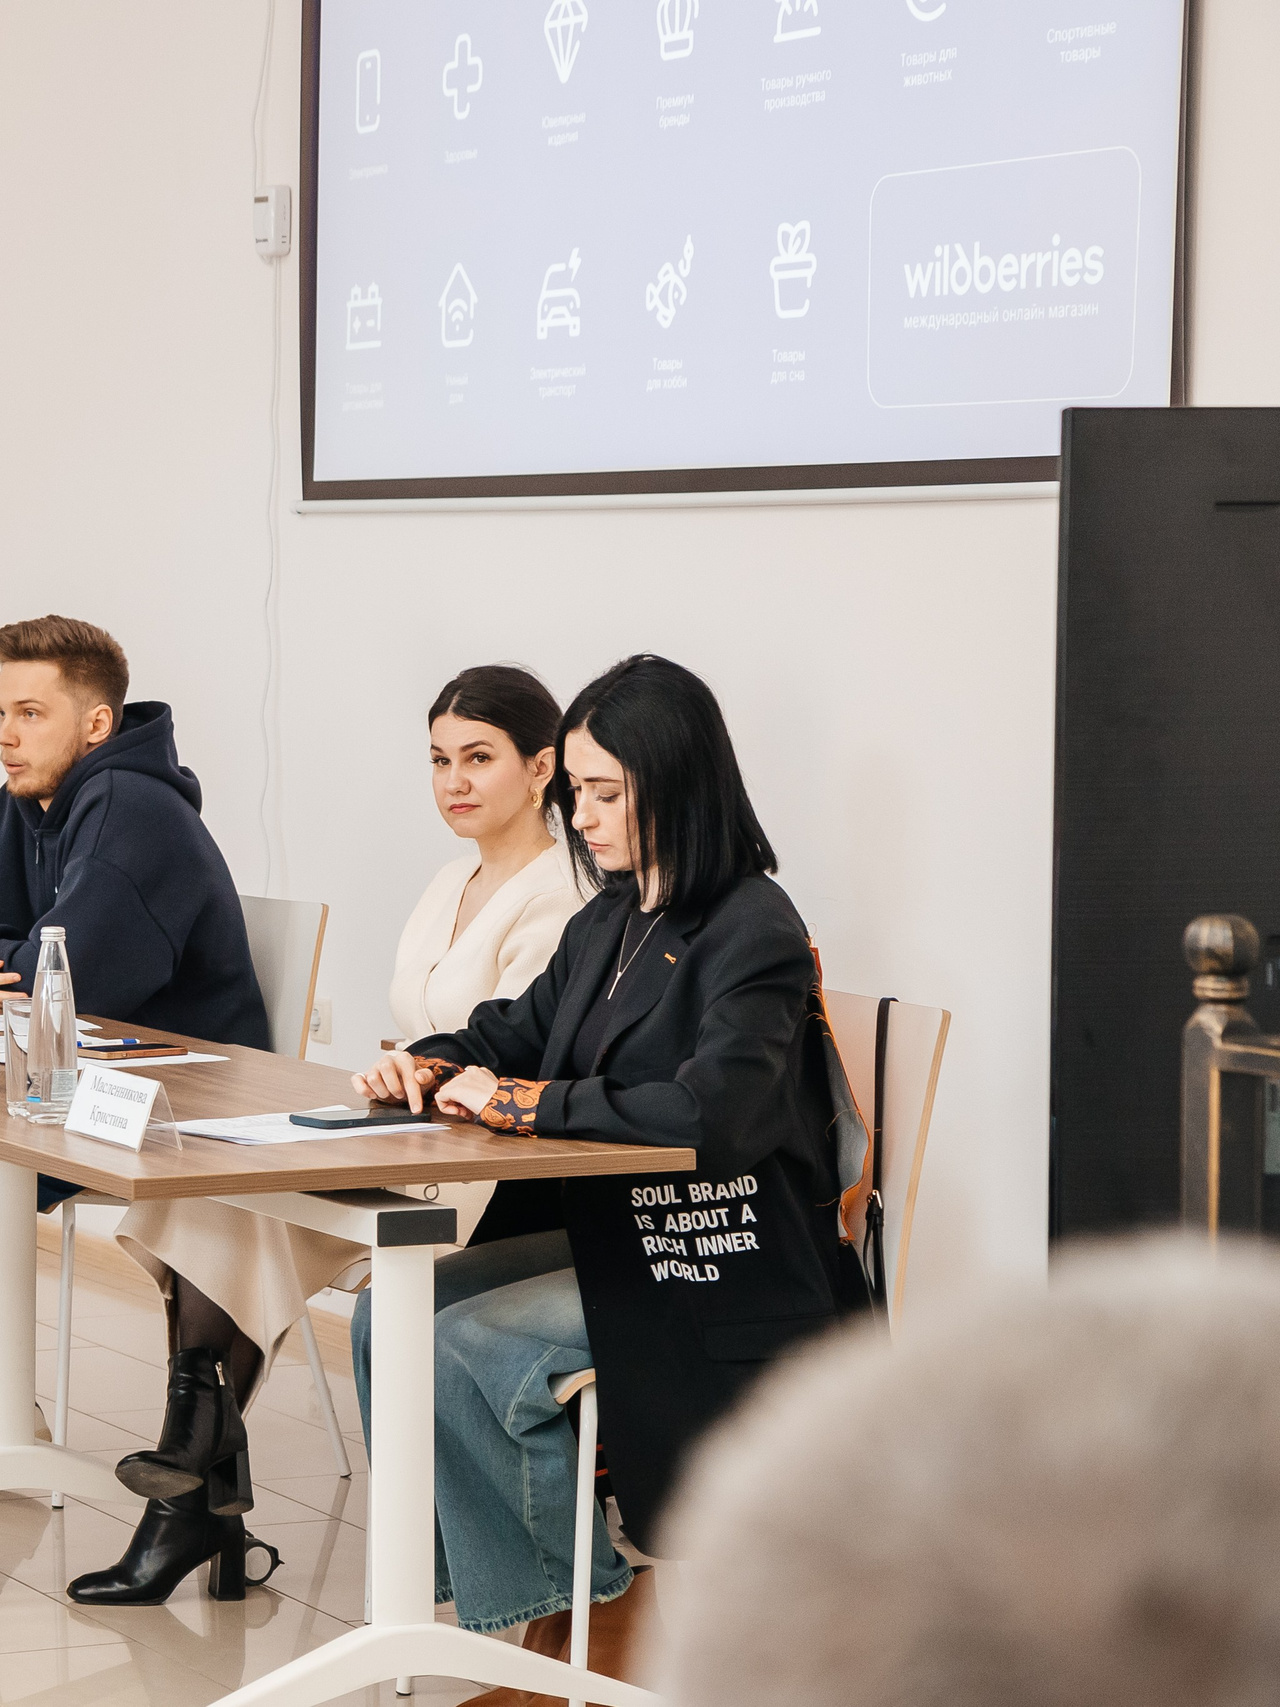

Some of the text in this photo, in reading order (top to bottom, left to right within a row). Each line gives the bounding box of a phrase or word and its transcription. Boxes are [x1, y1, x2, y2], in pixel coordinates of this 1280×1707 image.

[1046, 20, 1117, 45] Спортивные
[900, 46, 958, 68] Товары для
[1059, 45, 1101, 64] товары
[760, 68, 832, 93] Товары ручного
[903, 68, 953, 87] животных
[655, 93, 695, 112] Премиум
[763, 89, 826, 113] производства
[658, 112, 691, 130] бренды
[903, 233, 1105, 299] wildberries
[903, 302, 1099, 331] международный онлайн магазин
[652, 357, 683, 374] Товары
[771, 348, 805, 365] Товары
[646, 375, 688, 392] для хобби
[770, 369, 805, 385] для сна
[90, 1075, 148, 1104] Масленникова
[89, 1104, 129, 1129] Кристина
[631, 1175, 758, 1207] SOUL BRAND
[634, 1203, 757, 1233] IS ABOUT A
[642, 1231, 760, 1256] RICH INNER
[650, 1260, 720, 1282] WORLD
